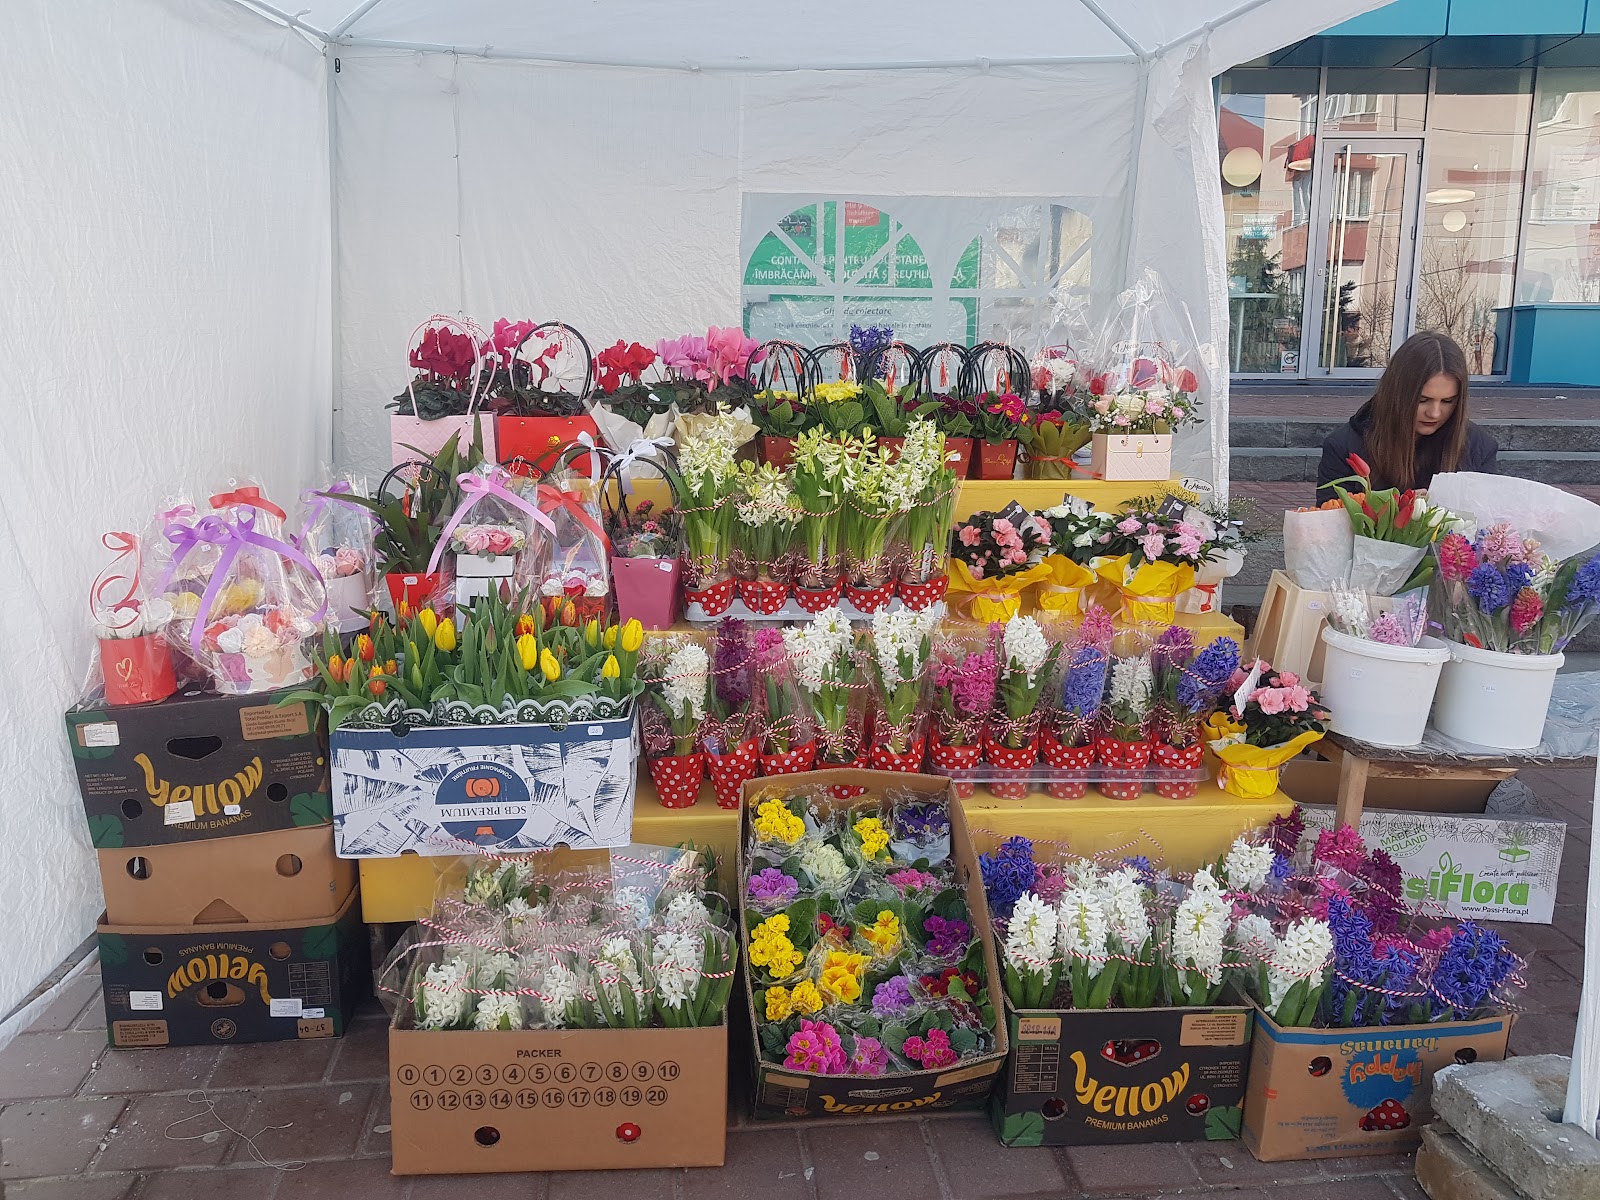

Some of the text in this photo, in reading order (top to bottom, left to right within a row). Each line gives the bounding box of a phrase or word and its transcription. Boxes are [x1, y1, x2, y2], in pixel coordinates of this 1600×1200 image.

[169, 819, 208, 830] REMIUM
[210, 809, 252, 829] BANANAS
[441, 805, 527, 818] SCB PREMIUM
[178, 943, 254, 957] PREMIUM BANANAS
[516, 1049, 562, 1058] PACKER
[1340, 1037, 1438, 1056] bananas
[660, 1065, 678, 1077] 10
[1350, 1053, 1423, 1086] happy
[413, 1090, 666, 1107] 11 12 13 14 15 16 17 18 19 20
[1084, 1114, 1169, 1131] PREMIUM BANANAS
